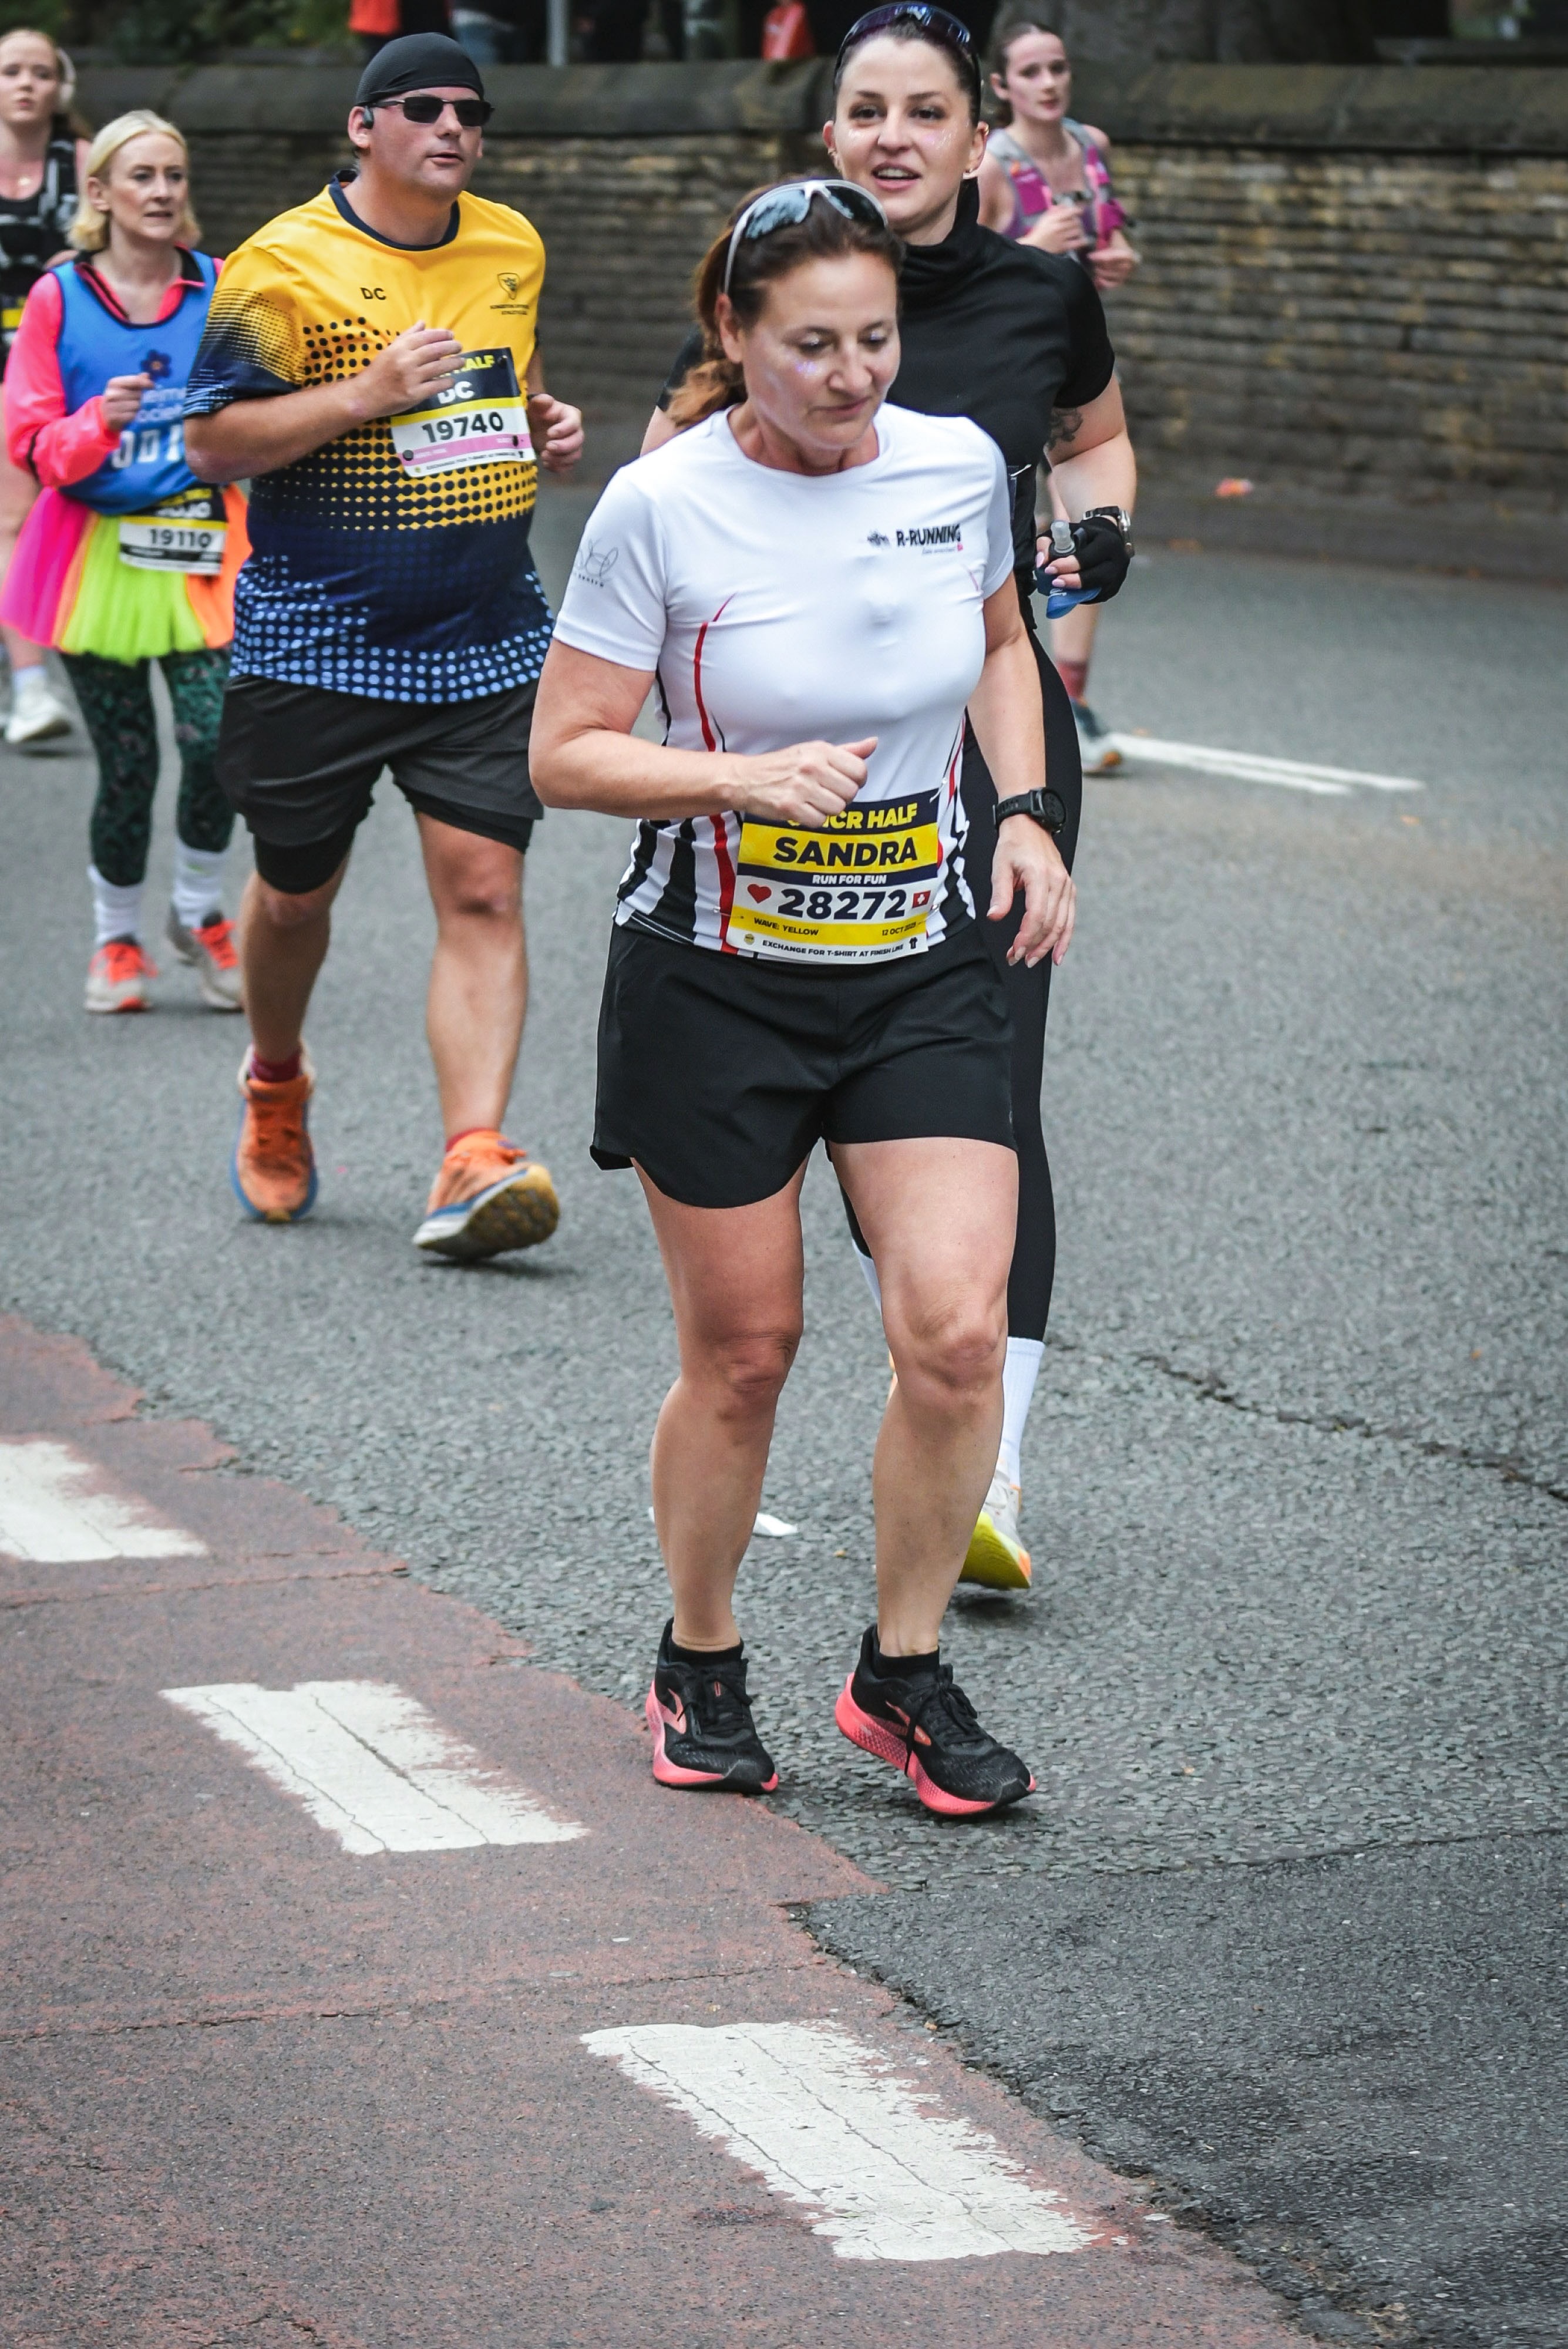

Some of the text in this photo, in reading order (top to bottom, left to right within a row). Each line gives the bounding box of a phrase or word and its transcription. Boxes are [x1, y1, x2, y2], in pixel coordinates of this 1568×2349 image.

[360, 287, 386, 300] DC
[421, 412, 503, 443] 19740
[150, 529, 212, 548] 19110
[896, 523, 961, 546] R-RUNNING
[867, 802, 918, 829] HALF
[773, 836, 917, 867] SANDRA
[812, 874, 887, 885] RUN FOR FUN
[778, 889, 907, 920] 28272
[783, 925, 819, 935] YELLOW
[890, 927, 904, 935] OCT
[762, 940, 807, 954] EXCHANGE
[870, 947, 891, 957] FINISH
